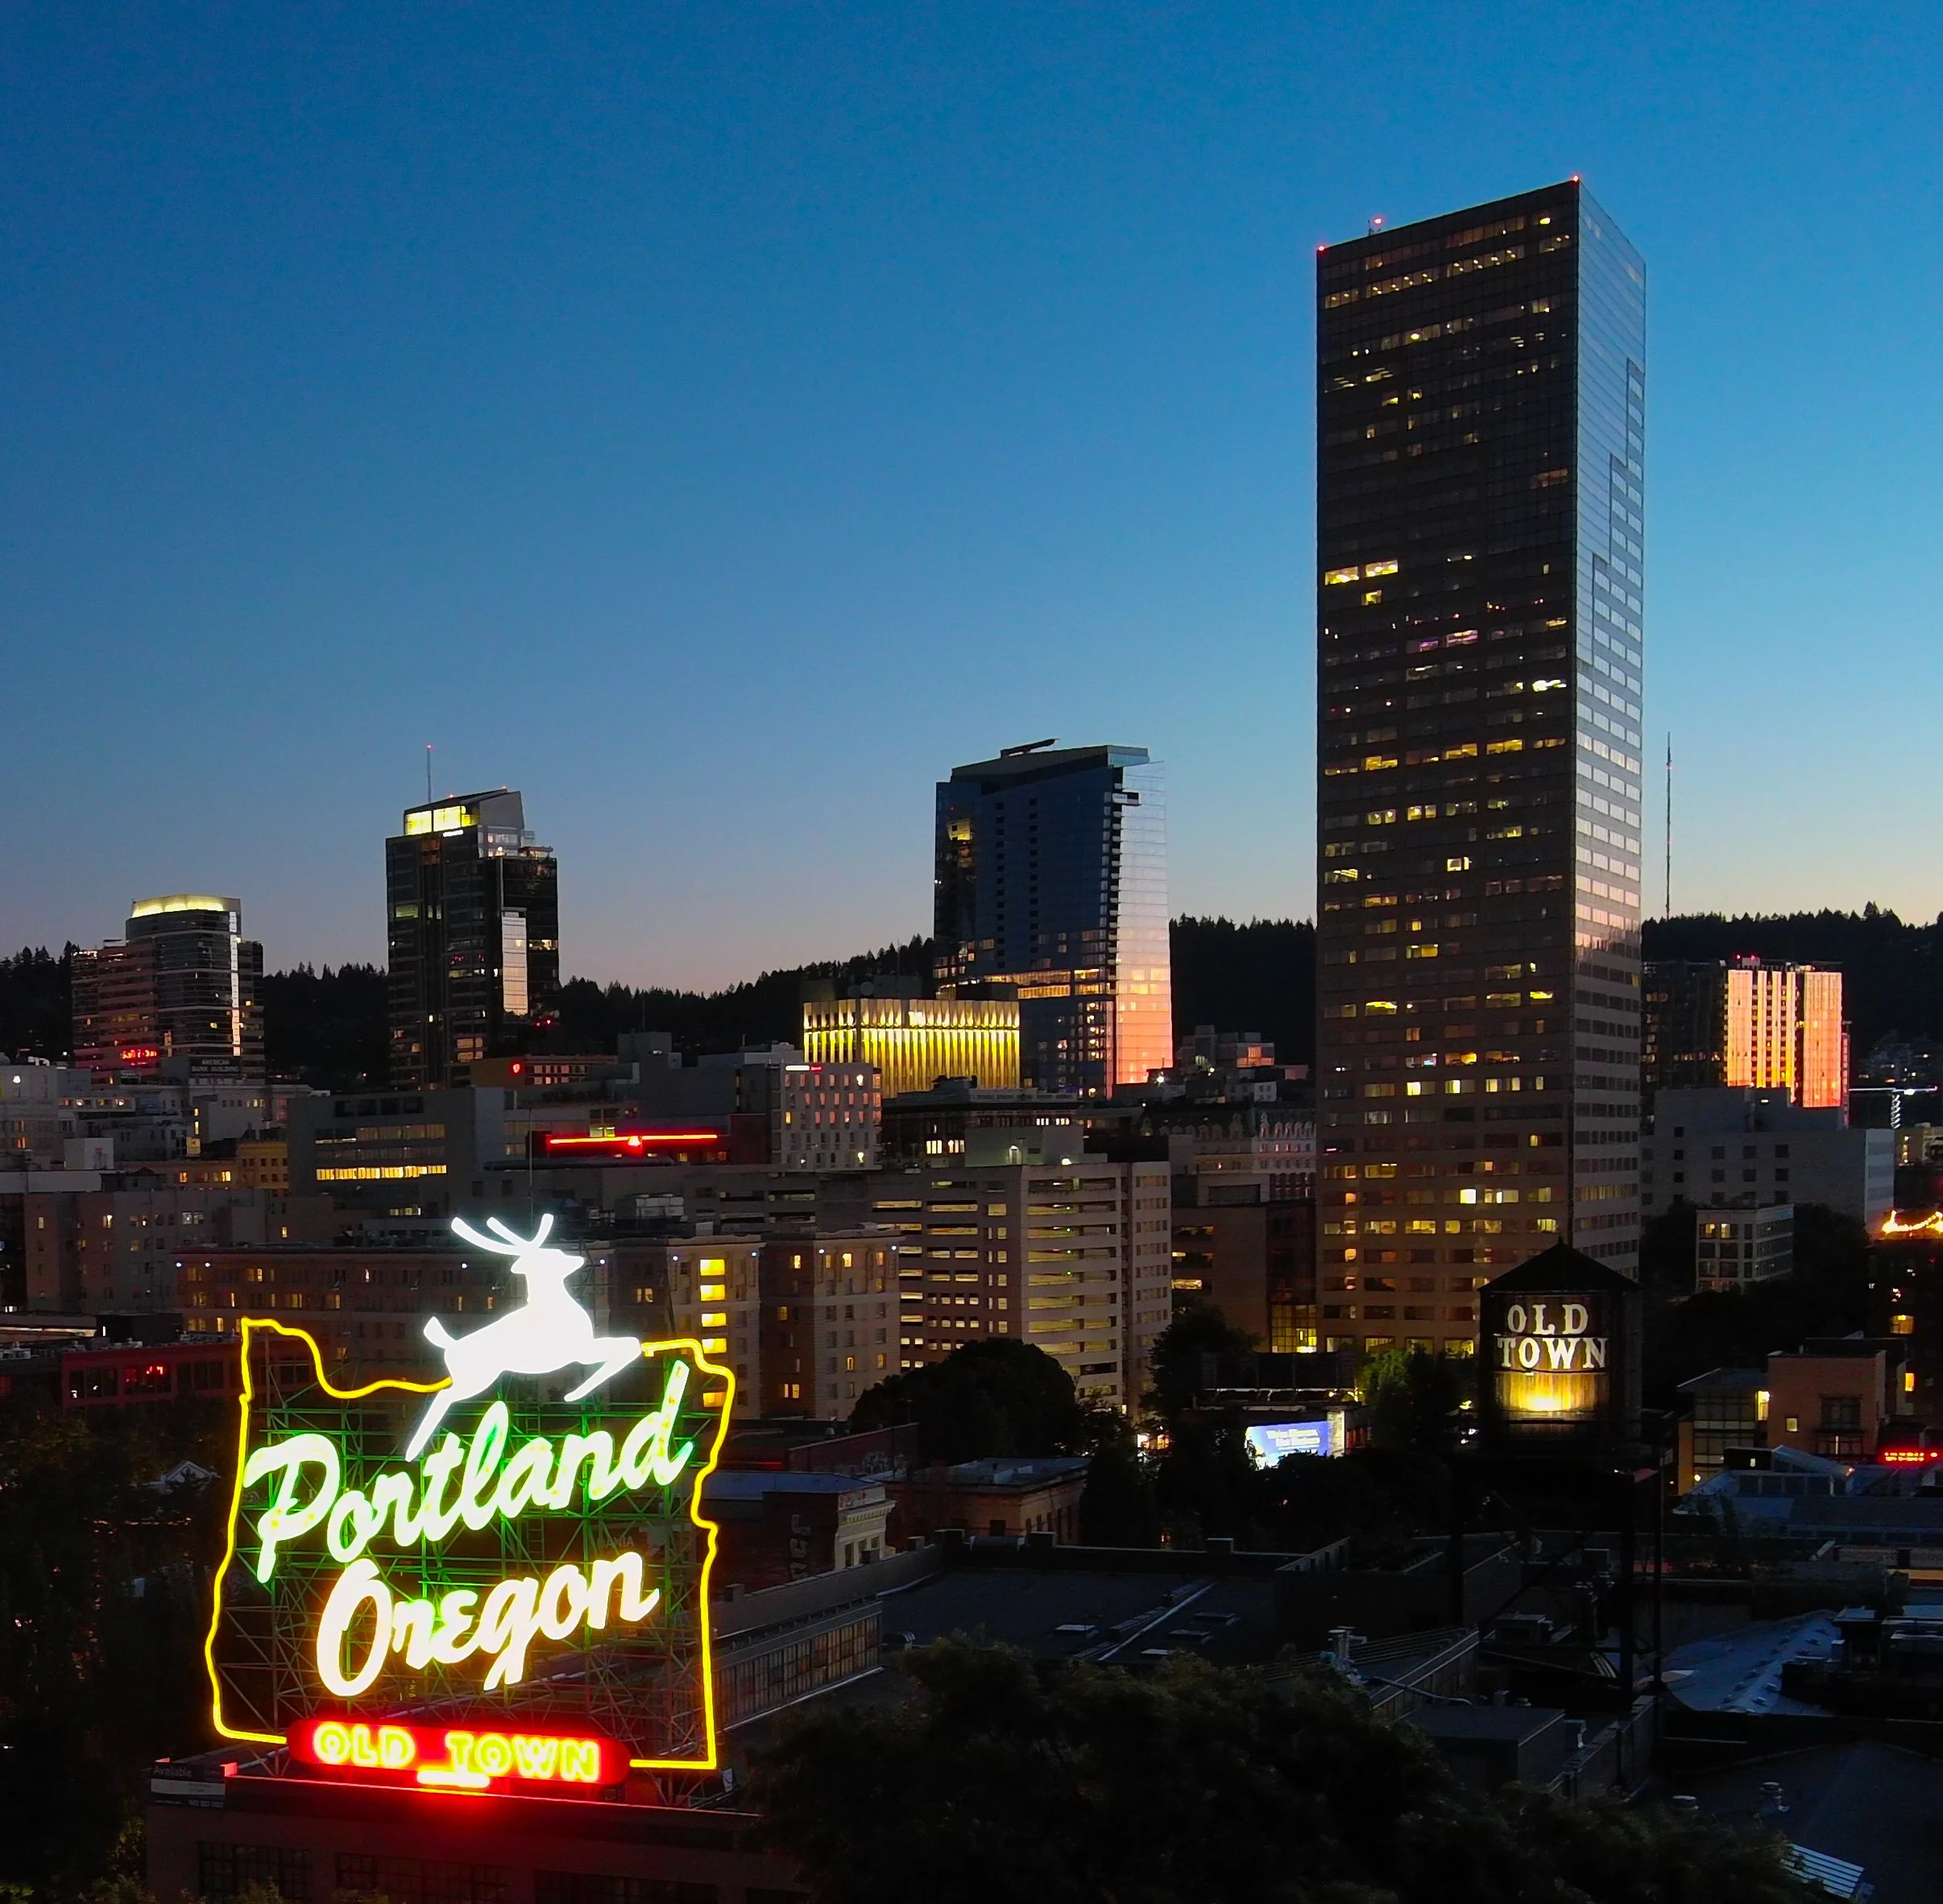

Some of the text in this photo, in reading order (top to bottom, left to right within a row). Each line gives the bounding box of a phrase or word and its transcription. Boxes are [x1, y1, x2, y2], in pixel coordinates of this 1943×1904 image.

[1507, 1304, 1589, 1335] OLD
[1497, 1337, 1607, 1369] TOWN
[243, 1361, 693, 1583] Portland
[317, 1551, 659, 1696] Oregon
[154, 1764, 193, 1777] Available
[313, 1722, 600, 1782] OLD TOWN
